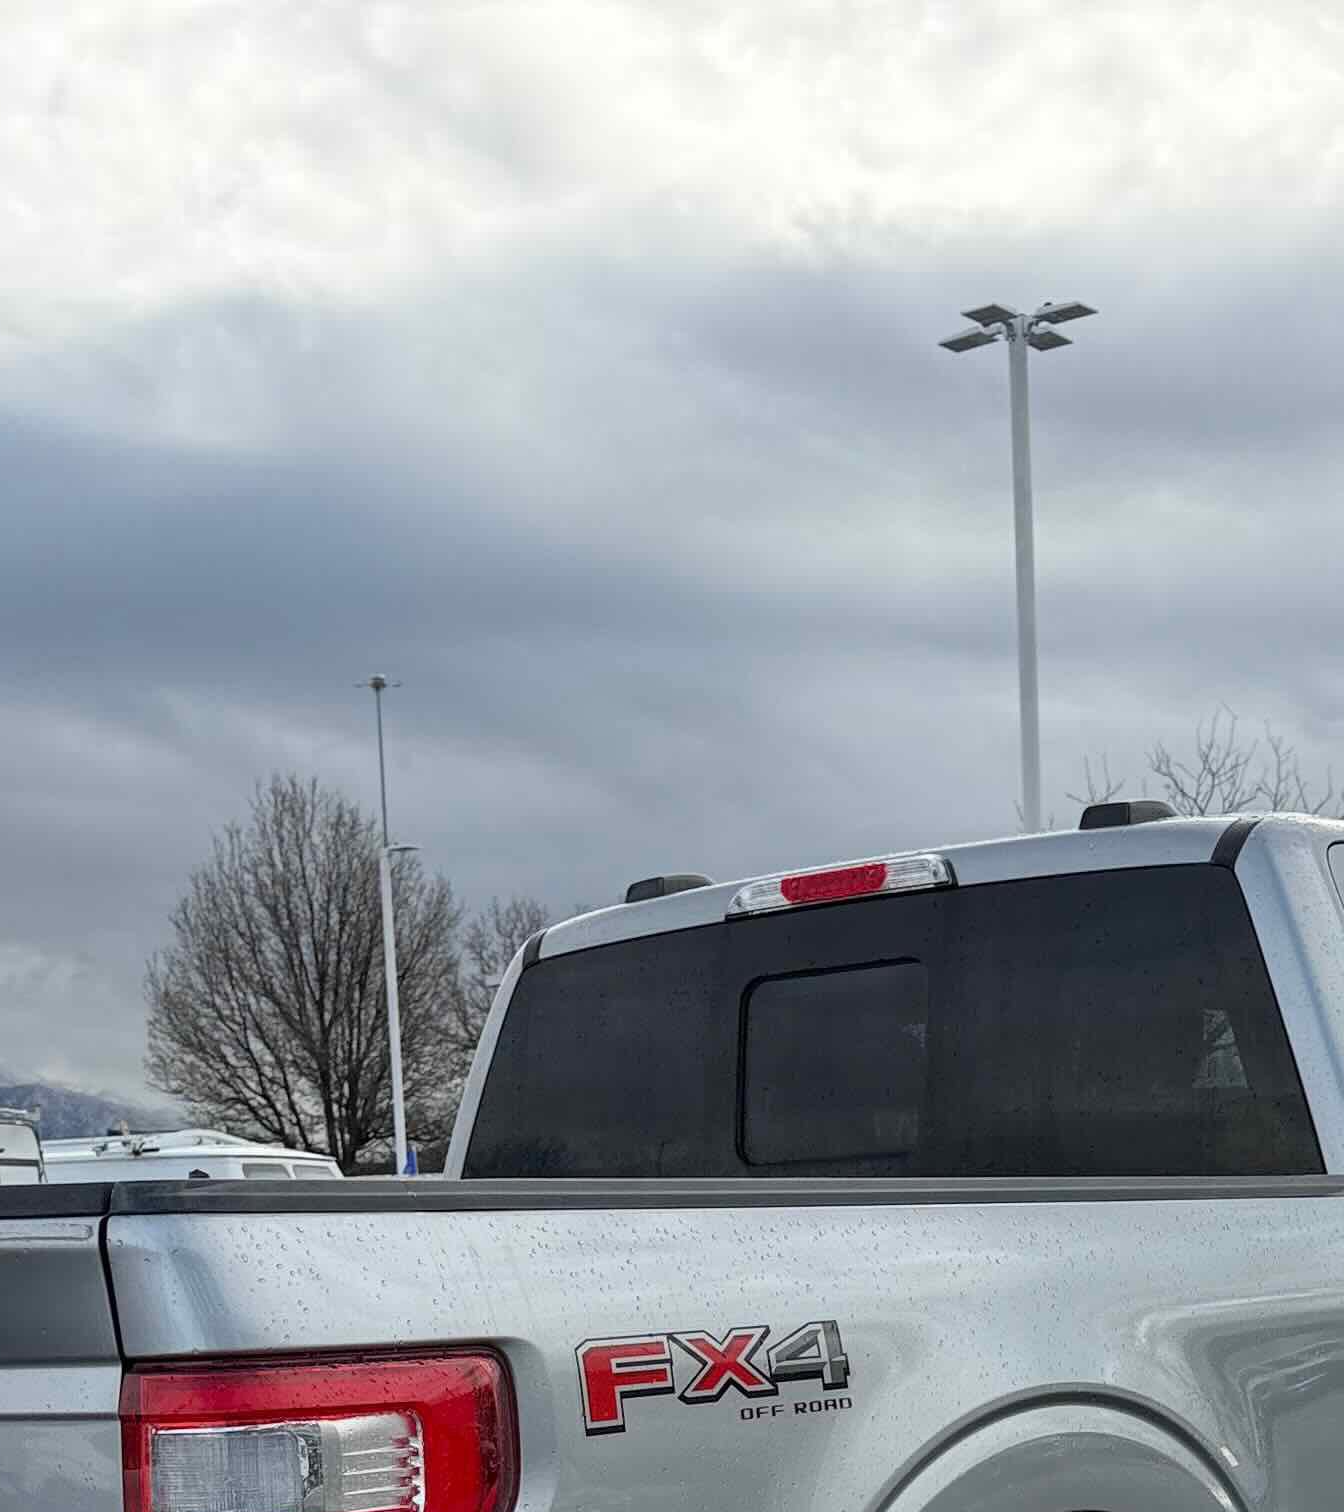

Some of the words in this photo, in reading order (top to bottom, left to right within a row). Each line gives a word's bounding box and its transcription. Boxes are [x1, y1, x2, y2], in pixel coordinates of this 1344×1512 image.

[574, 1319, 851, 1437] FX4
[740, 1404, 786, 1421] OFF
[794, 1397, 853, 1415] ROAD
